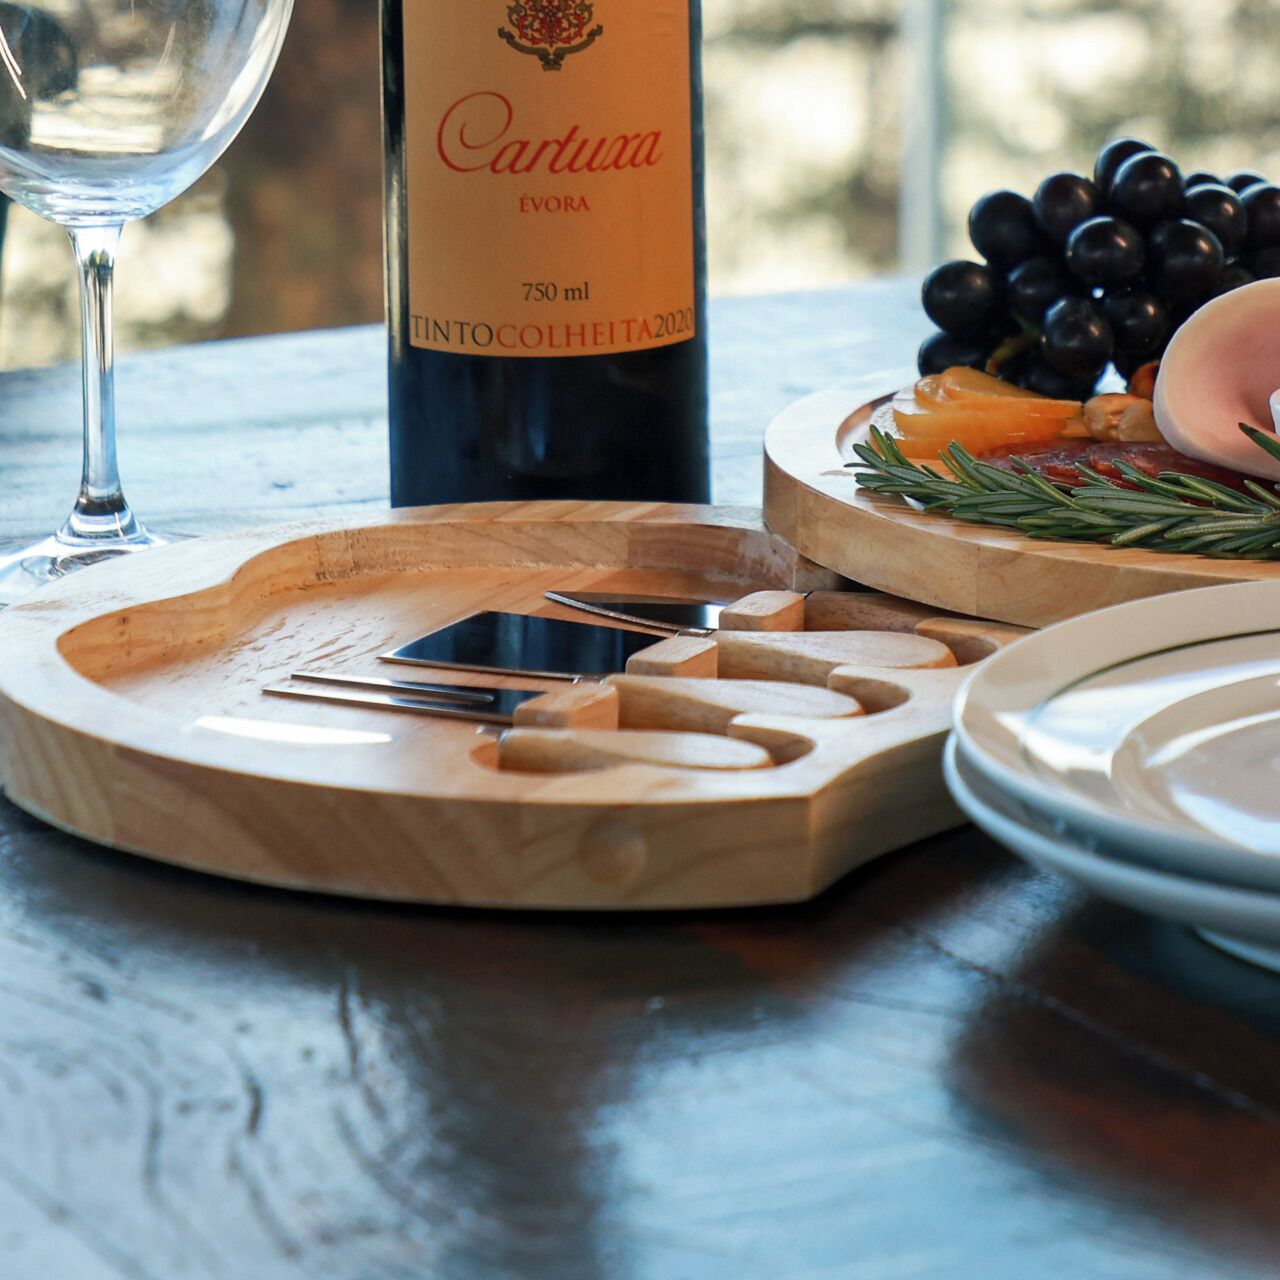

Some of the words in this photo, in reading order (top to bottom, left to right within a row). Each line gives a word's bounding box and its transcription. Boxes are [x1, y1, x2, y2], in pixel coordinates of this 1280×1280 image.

[437, 90, 663, 175] Cartuxa
[519, 192, 590, 213] ÉVORA
[522, 282, 558, 302] 750
[564, 281, 590, 301] ml
